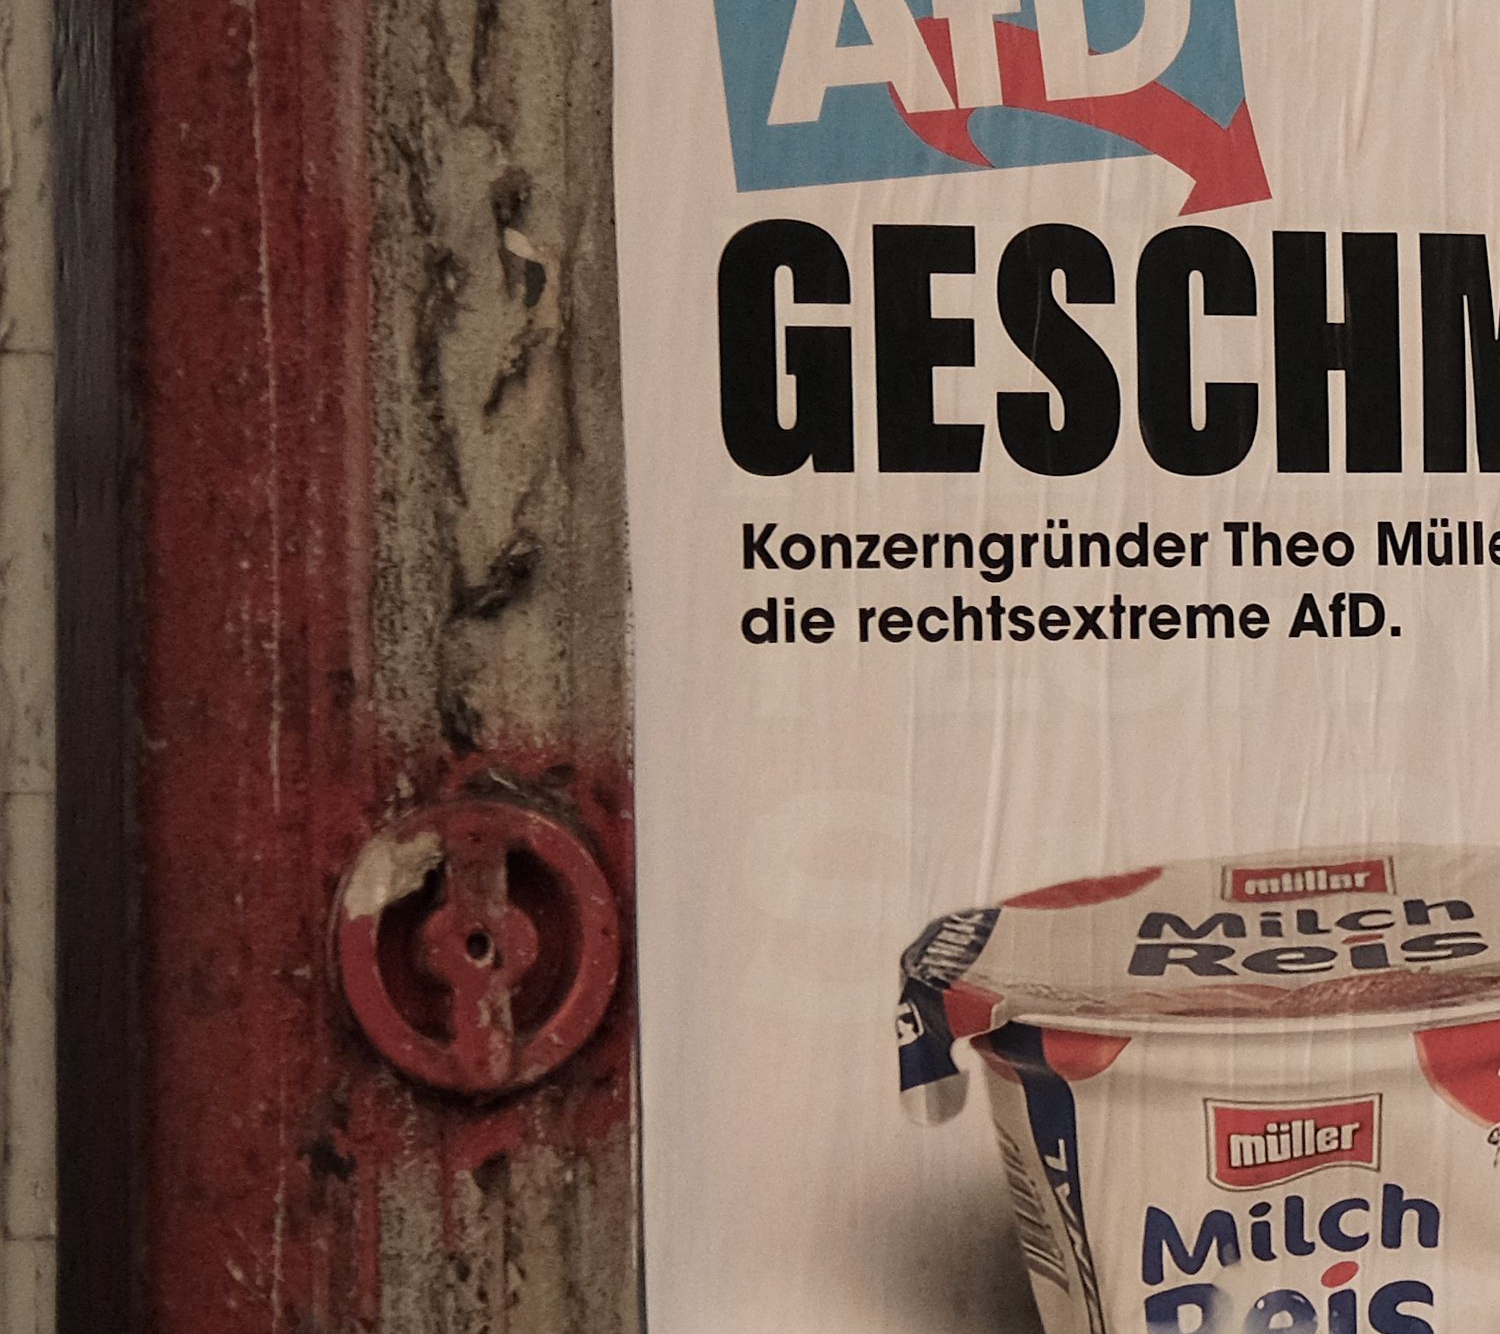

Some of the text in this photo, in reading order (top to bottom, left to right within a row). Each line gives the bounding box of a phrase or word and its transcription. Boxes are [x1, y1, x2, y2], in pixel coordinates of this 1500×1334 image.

[742, 518, 1209, 583] Konzerngründer
[1223, 521, 1356, 568] Theo
[740, 591, 1402, 645] die rechtsextreme AfD.
[1137, 898, 1474, 939] Milch
[1127, 930, 1490, 977] Reis
[1229, 1118, 1360, 1168] müller
[1142, 1183, 1440, 1286] Milch
